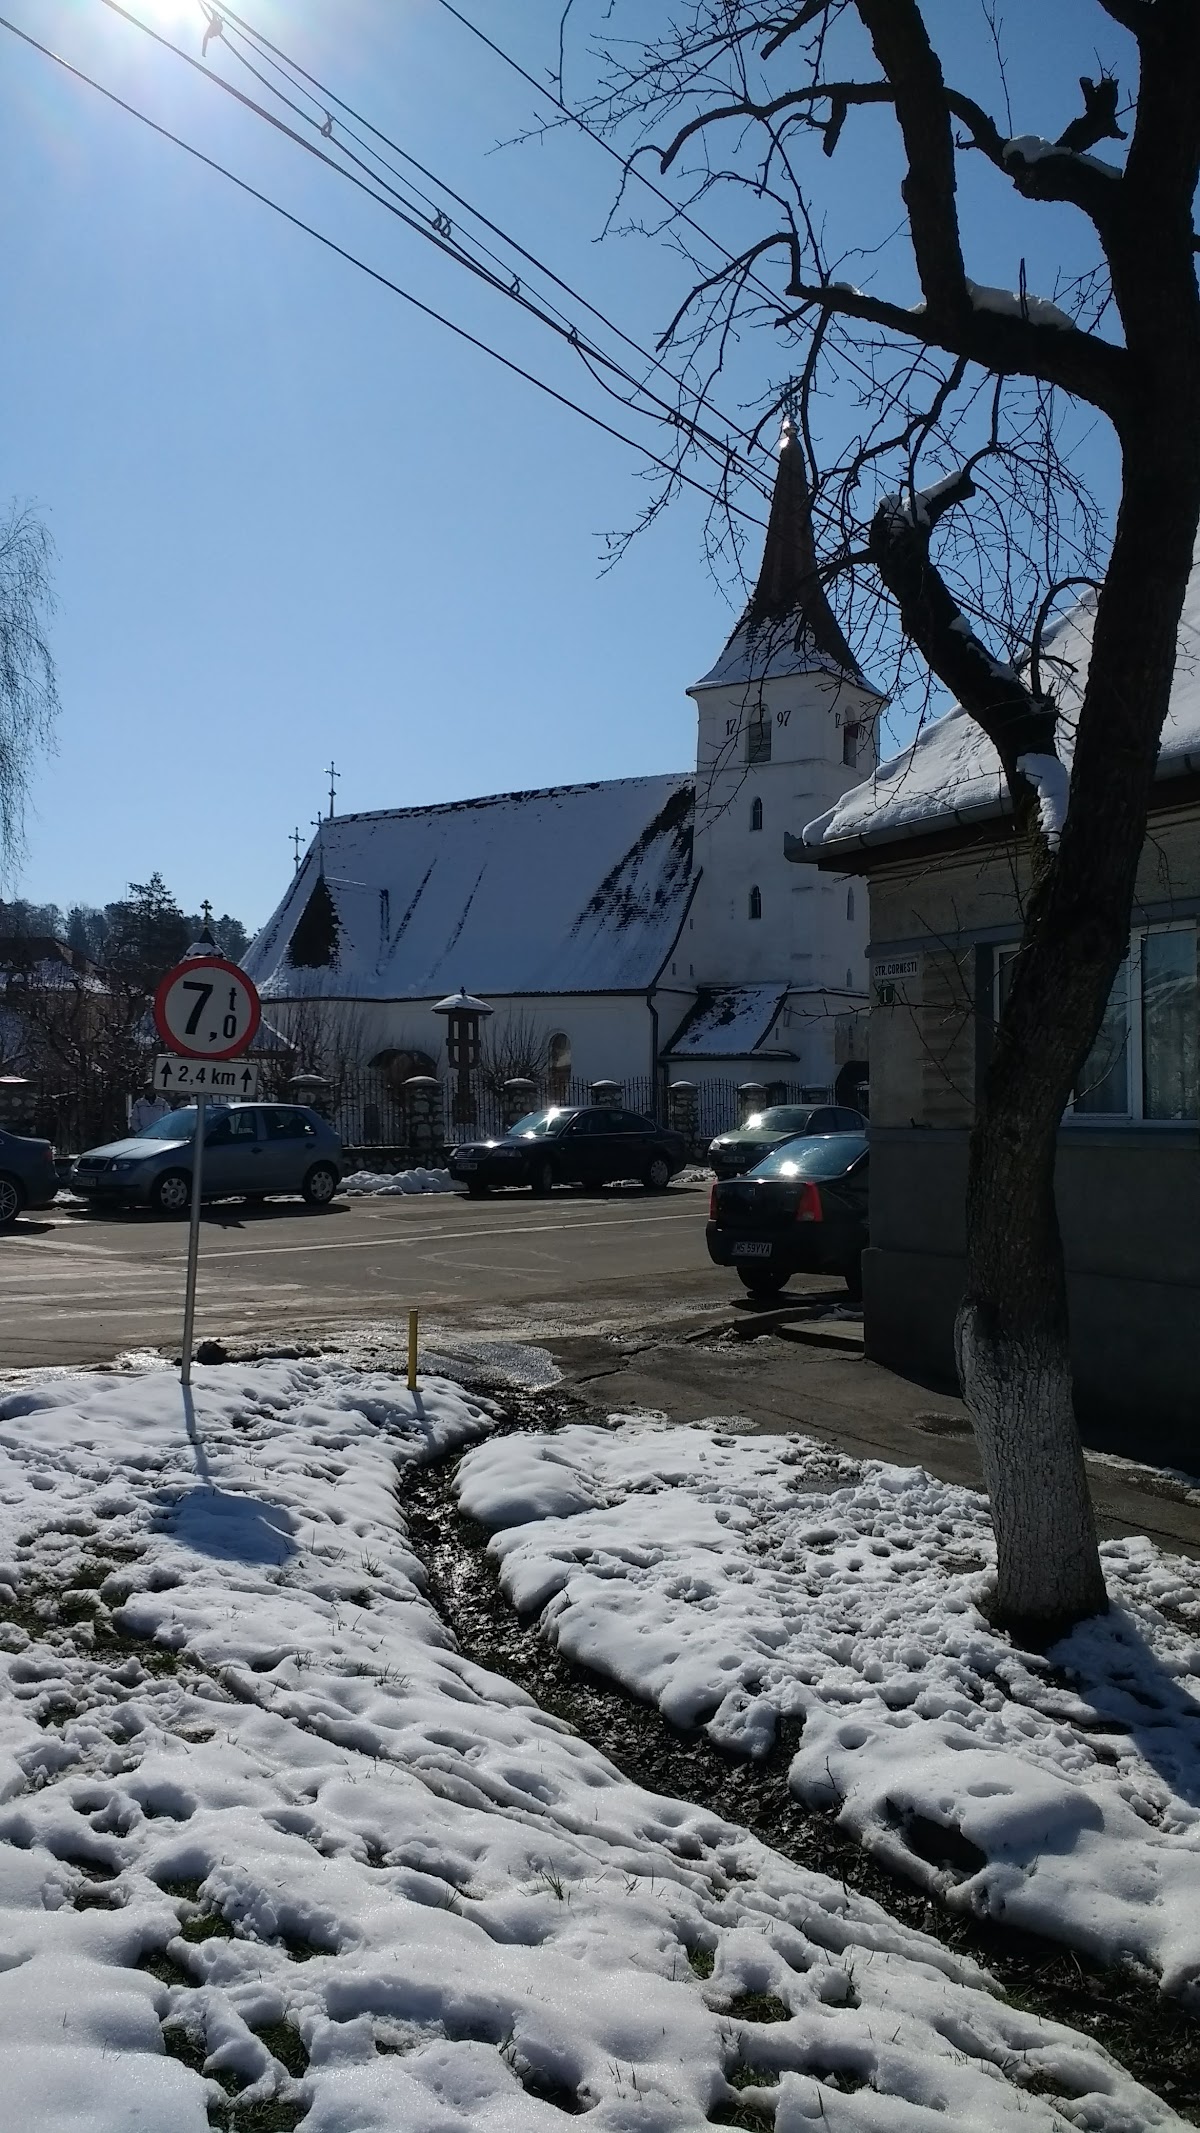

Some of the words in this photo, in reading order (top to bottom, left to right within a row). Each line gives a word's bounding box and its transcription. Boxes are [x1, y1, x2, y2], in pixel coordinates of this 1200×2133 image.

[726, 719, 737, 735] 17
[777, 711, 791, 727] 97
[229, 987, 237, 1011] t
[178, 1065, 206, 1085] 2,4
[211, 1067, 235, 1086] km
